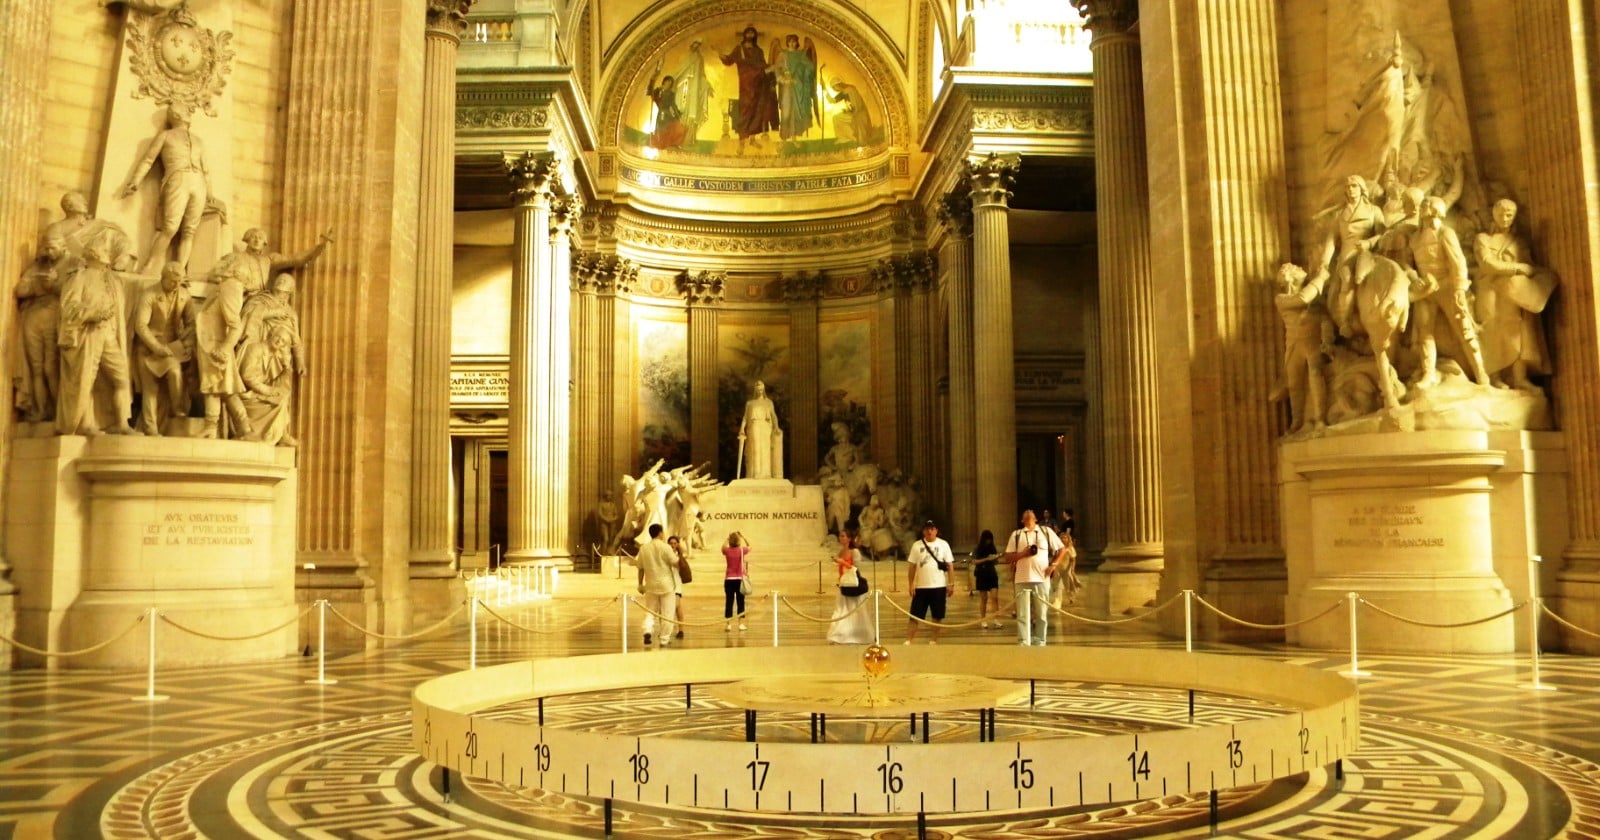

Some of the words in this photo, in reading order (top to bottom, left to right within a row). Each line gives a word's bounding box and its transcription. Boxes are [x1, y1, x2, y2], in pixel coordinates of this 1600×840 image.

[832, 176, 852, 188] FATA
[164, 512, 183, 522] AVX
[189, 512, 239, 522] ORATEVRS
[167, 525, 185, 534] AVX
[714, 512, 769, 520] CONVENTION
[772, 512, 818, 520] NATIONALE
[143, 536, 159, 545] DE
[166, 536, 180, 545] LA
[465, 731, 478, 759] 20
[1226, 740, 1243, 768] 13
[1297, 728, 1310, 755] 12
[534, 744, 550, 771] 19
[628, 754, 649, 784] 18
[1127, 750, 1151, 782] 14
[746, 761, 770, 791] 17
[877, 762, 903, 794] 16
[1009, 758, 1034, 789] 15
